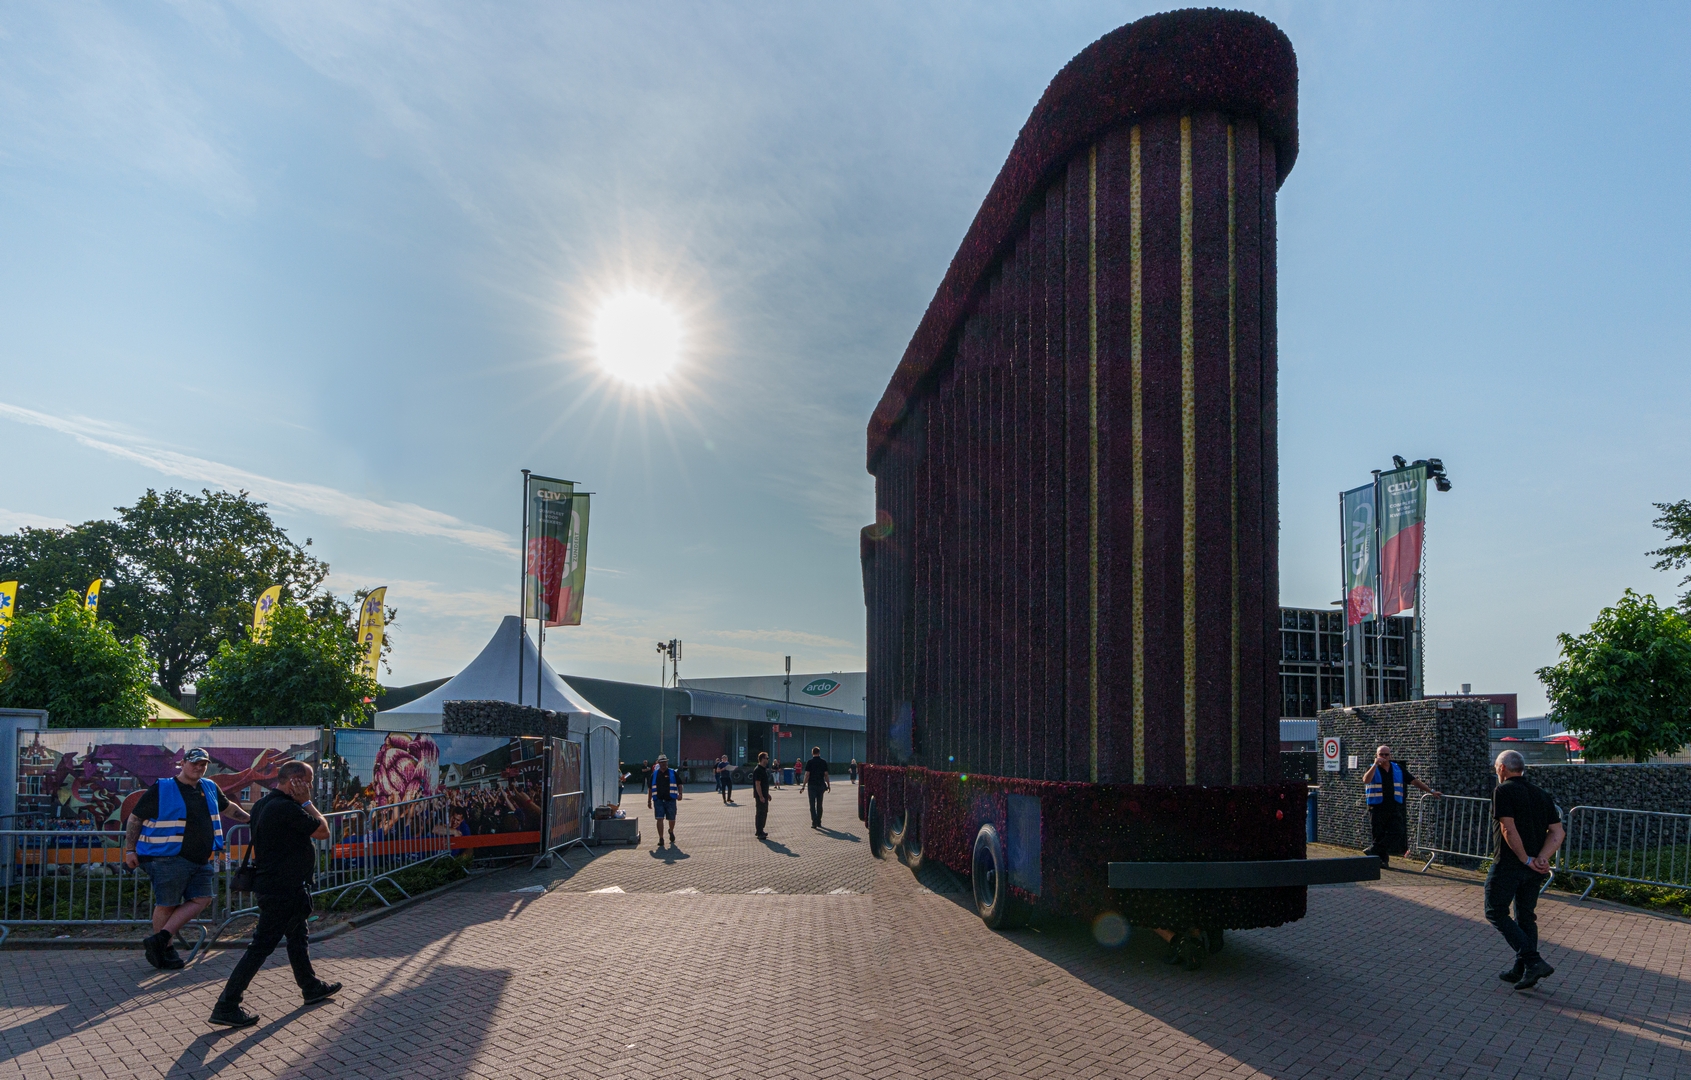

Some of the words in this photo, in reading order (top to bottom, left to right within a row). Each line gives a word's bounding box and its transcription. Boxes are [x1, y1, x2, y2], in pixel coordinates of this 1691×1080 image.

[1387, 480, 1413, 493] CLTV
[537, 489, 561, 500] CLTV
[1352, 520, 1366, 576] CLTV
[806, 682, 832, 692] ardo
[1328, 745, 1336, 753] 15
